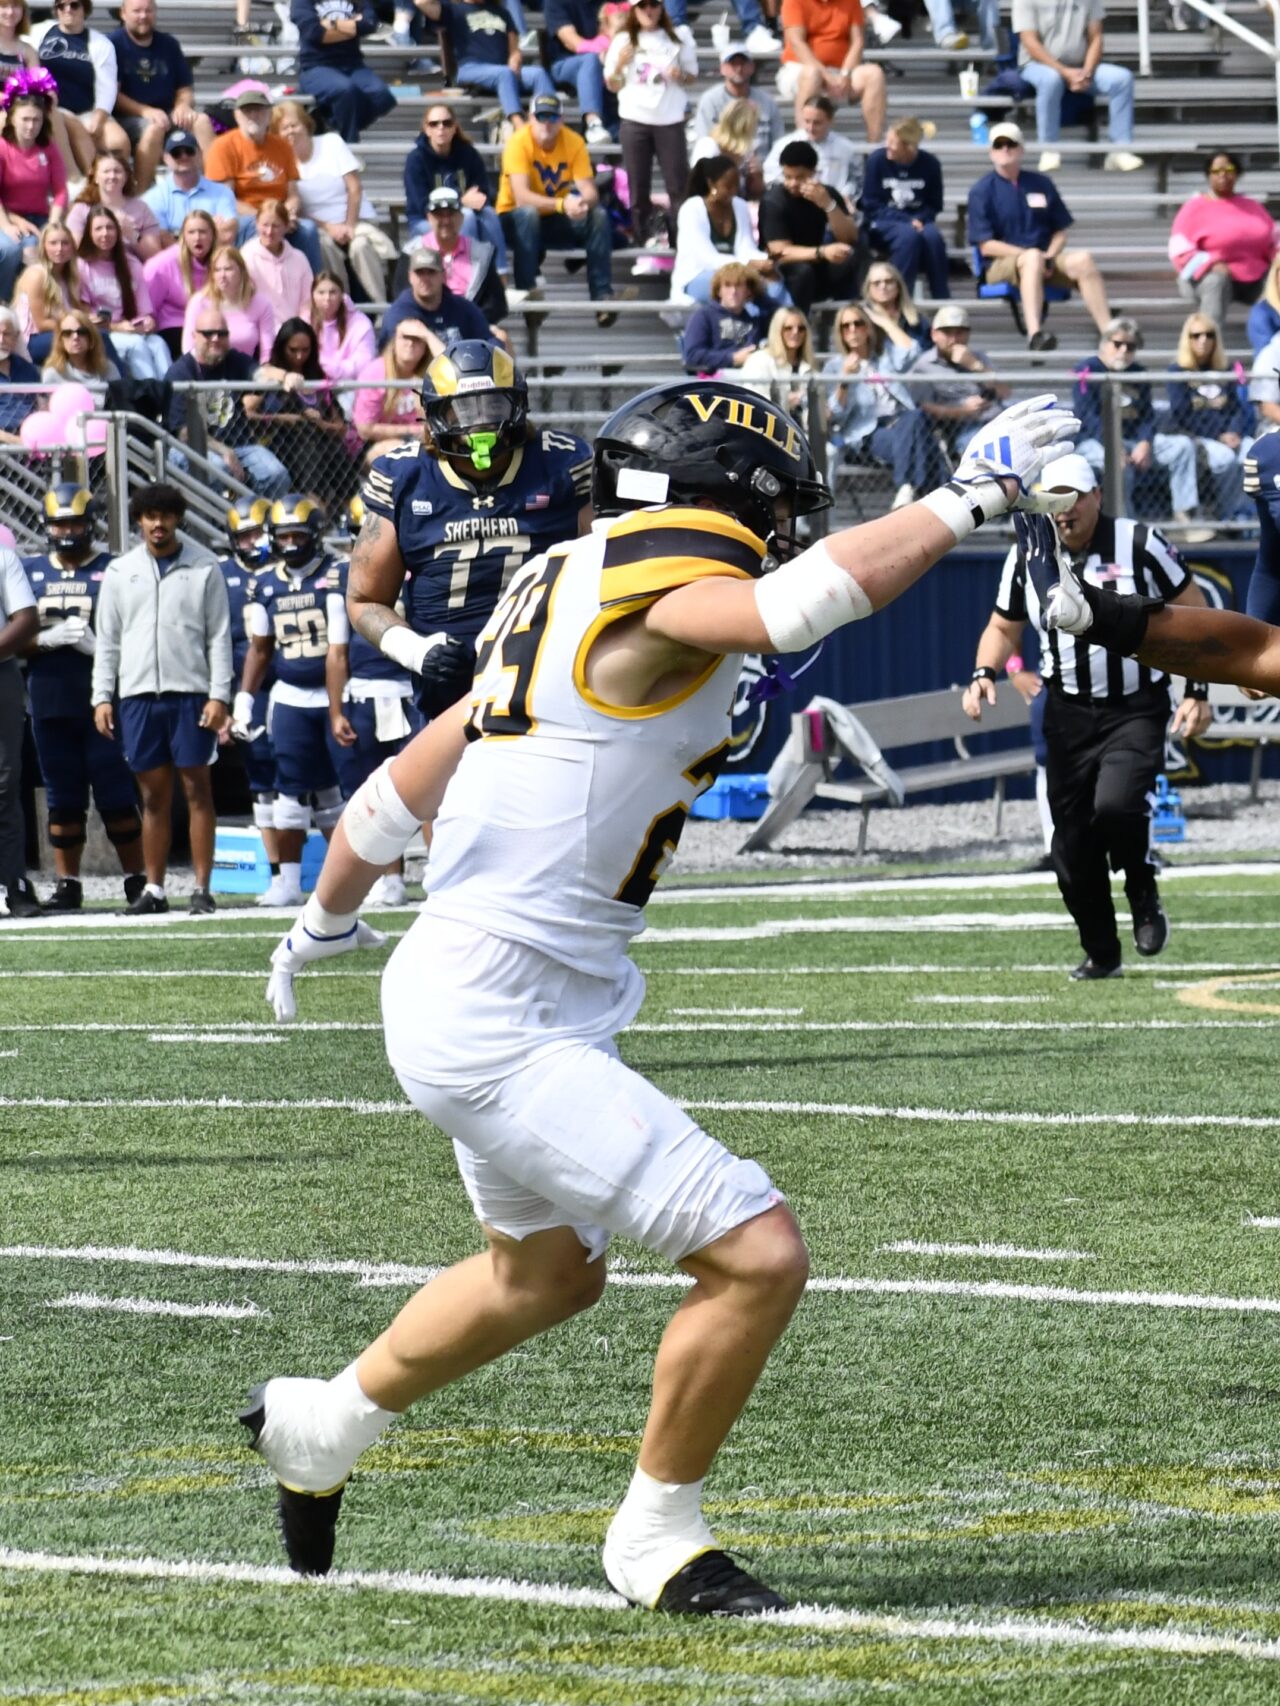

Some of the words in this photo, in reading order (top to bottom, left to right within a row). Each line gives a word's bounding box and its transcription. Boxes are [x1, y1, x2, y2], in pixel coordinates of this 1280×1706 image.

[683, 393, 801, 461] VILLE
[444, 517, 519, 542] SHEPHERD
[433, 535, 531, 608] 77
